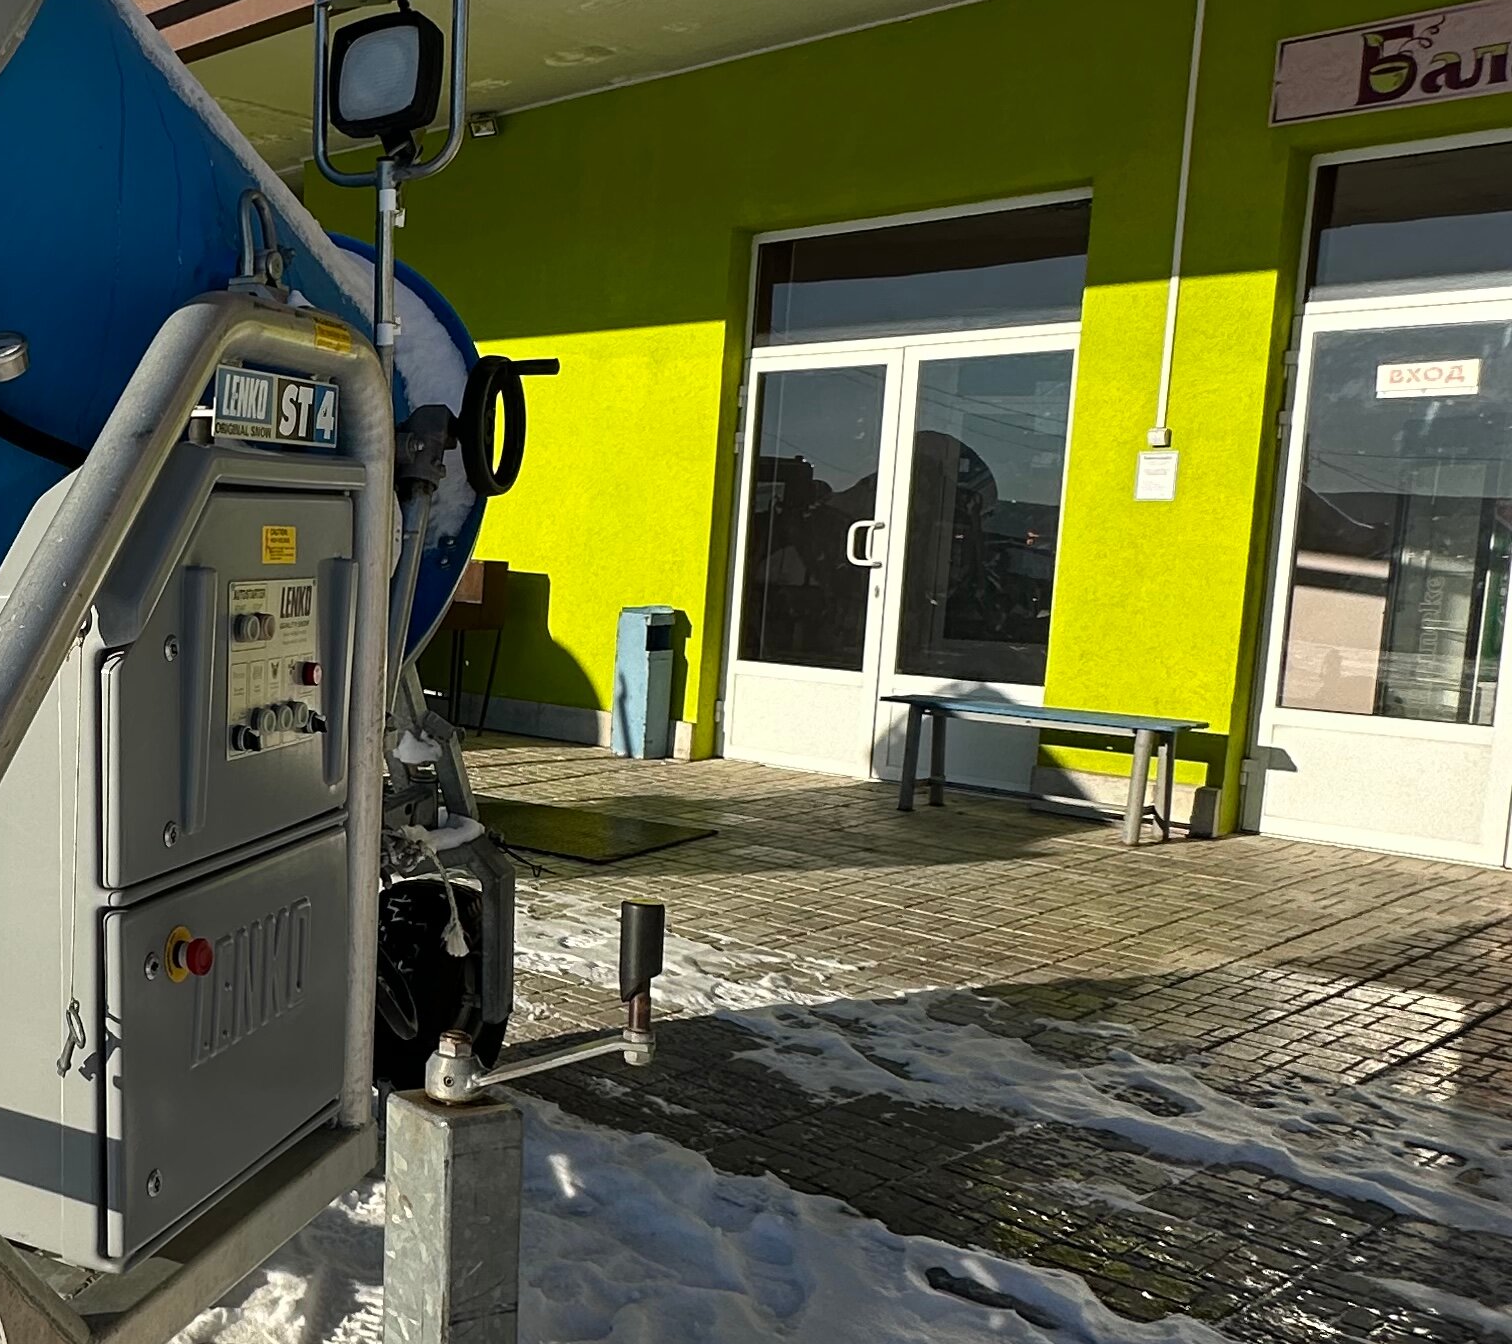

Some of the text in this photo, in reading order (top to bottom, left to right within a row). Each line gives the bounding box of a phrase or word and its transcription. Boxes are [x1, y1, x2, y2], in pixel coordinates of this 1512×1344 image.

[1389, 365, 1465, 384] ВХОД
[222, 373, 269, 420] LENKO
[278, 383, 336, 440] ST 4
[251, 425, 272, 439] SNOW
[279, 585, 313, 619] LENKO
[190, 895, 312, 1069] LENKO
